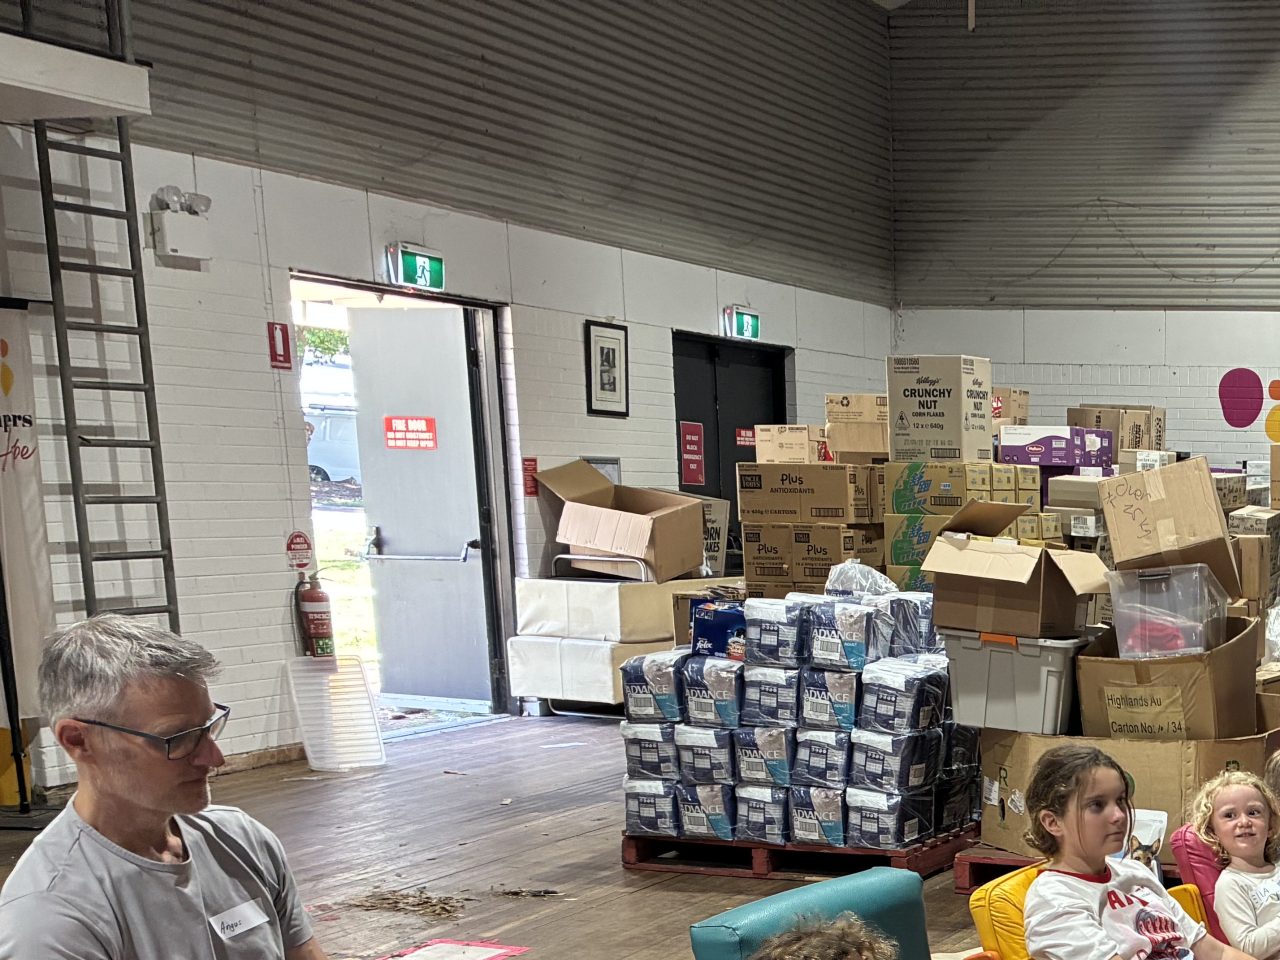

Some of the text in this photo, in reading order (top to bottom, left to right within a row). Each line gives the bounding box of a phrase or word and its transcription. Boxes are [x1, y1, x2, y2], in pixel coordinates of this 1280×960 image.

[903, 388, 953, 399] CRUNCHY
[966, 389, 989, 400] CRUNCHY
[918, 399, 938, 410] NUT
[780, 473, 804, 486] Plus
[757, 543, 779, 555] Plus
[806, 544, 828, 556] Plus
[812, 628, 860, 641] ADVANCE
[625, 684, 669, 695] ADVANCE
[685, 688, 729, 699] ADVANCE
[804, 689, 849, 702] ADVANCE
[1107, 693, 1148, 709] Highlands
[1111, 720, 1139, 733] Carton
[1171, 721, 1183, 733] 34
[737, 749, 780, 759] ADVANCE
[681, 803, 723, 813] ADVANCE
[793, 808, 836, 820] ADVANCE
[220, 919, 242, 934] Angus
